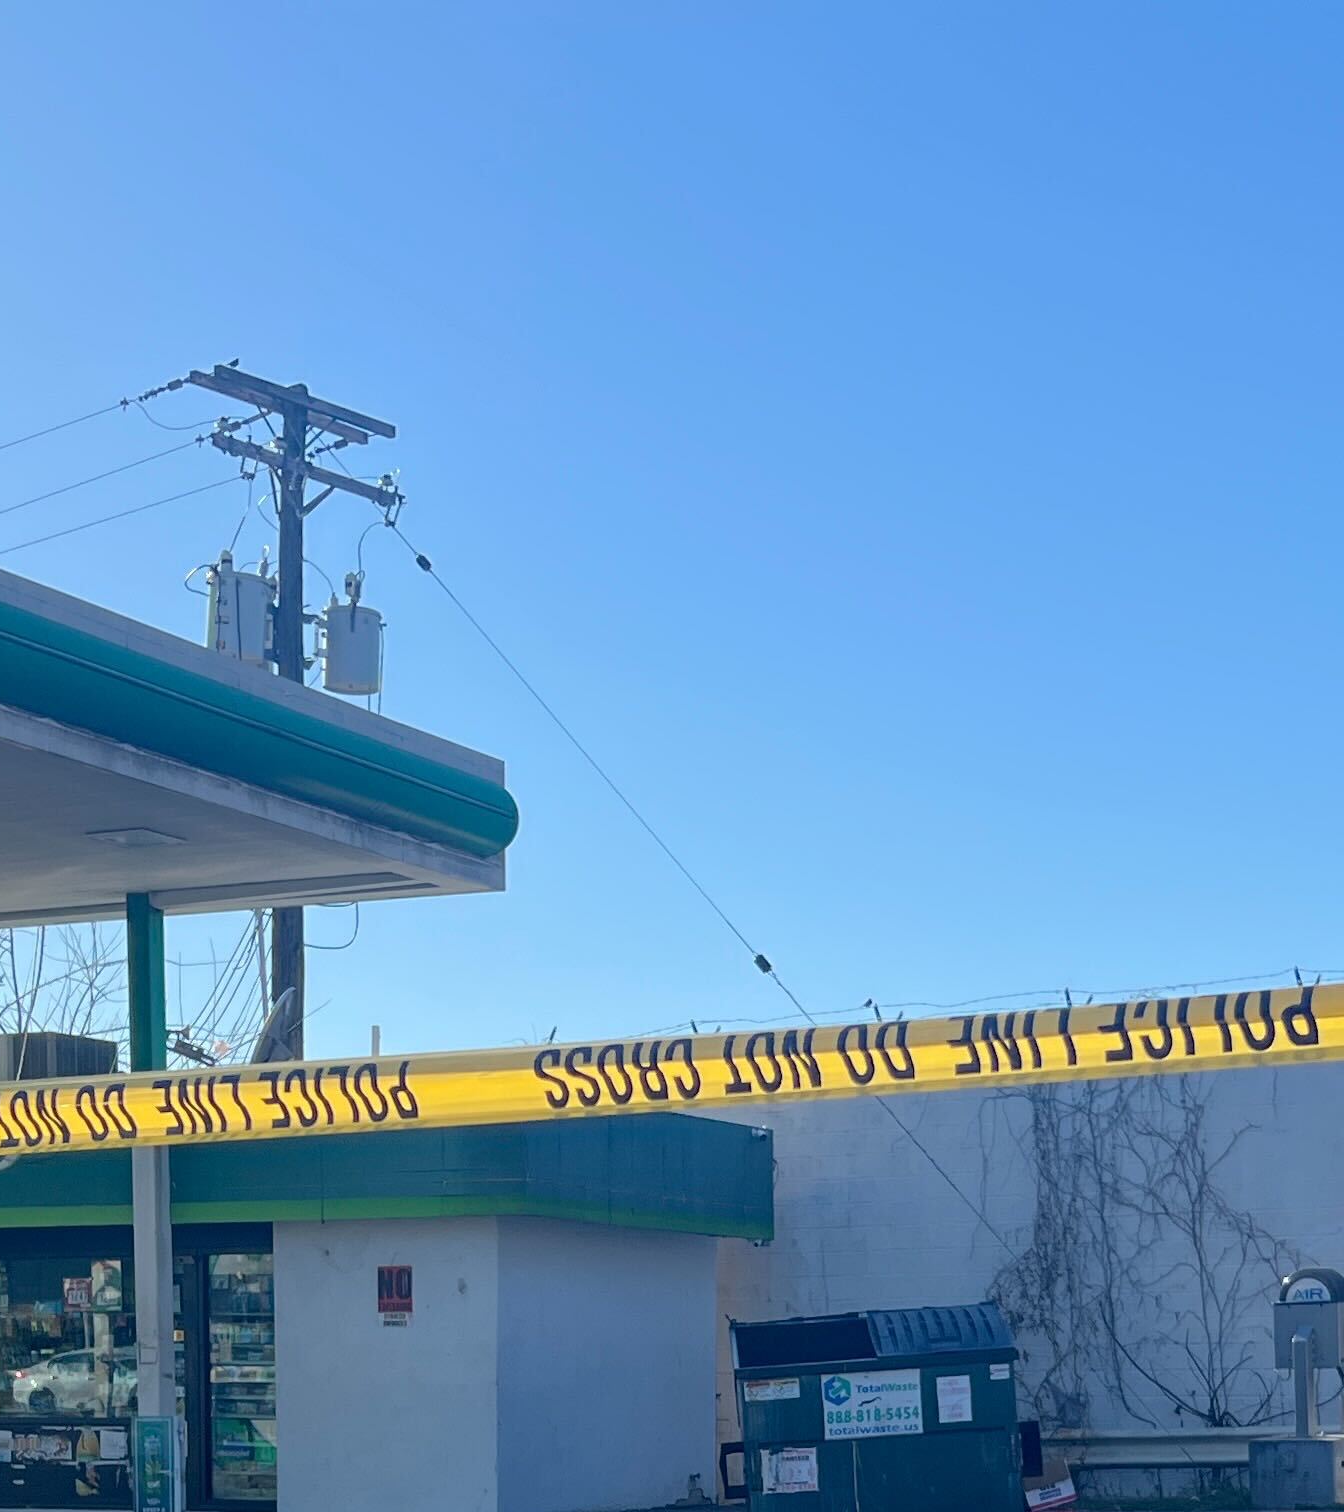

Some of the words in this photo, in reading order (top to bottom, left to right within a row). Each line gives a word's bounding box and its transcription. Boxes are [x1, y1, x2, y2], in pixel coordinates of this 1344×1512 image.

[836, 1020, 916, 1086] DO
[946, 1006, 1077, 1075] LINE
[1097, 984, 1319, 1062] POLICE
[533, 1038, 702, 1110] CROSS
[722, 1026, 822, 1096] NOT
[75, 1082, 138, 1142] DO
[151, 1074, 253, 1136] LINE
[259, 1060, 419, 1129] POLICE
[1292, 1288, 1324, 1301] AIR
[826, 1406, 921, 1425] 888-818-5454
[855, 1382, 919, 1394] TotalWaste
[829, 1423, 920, 1437] totalwaste.us
